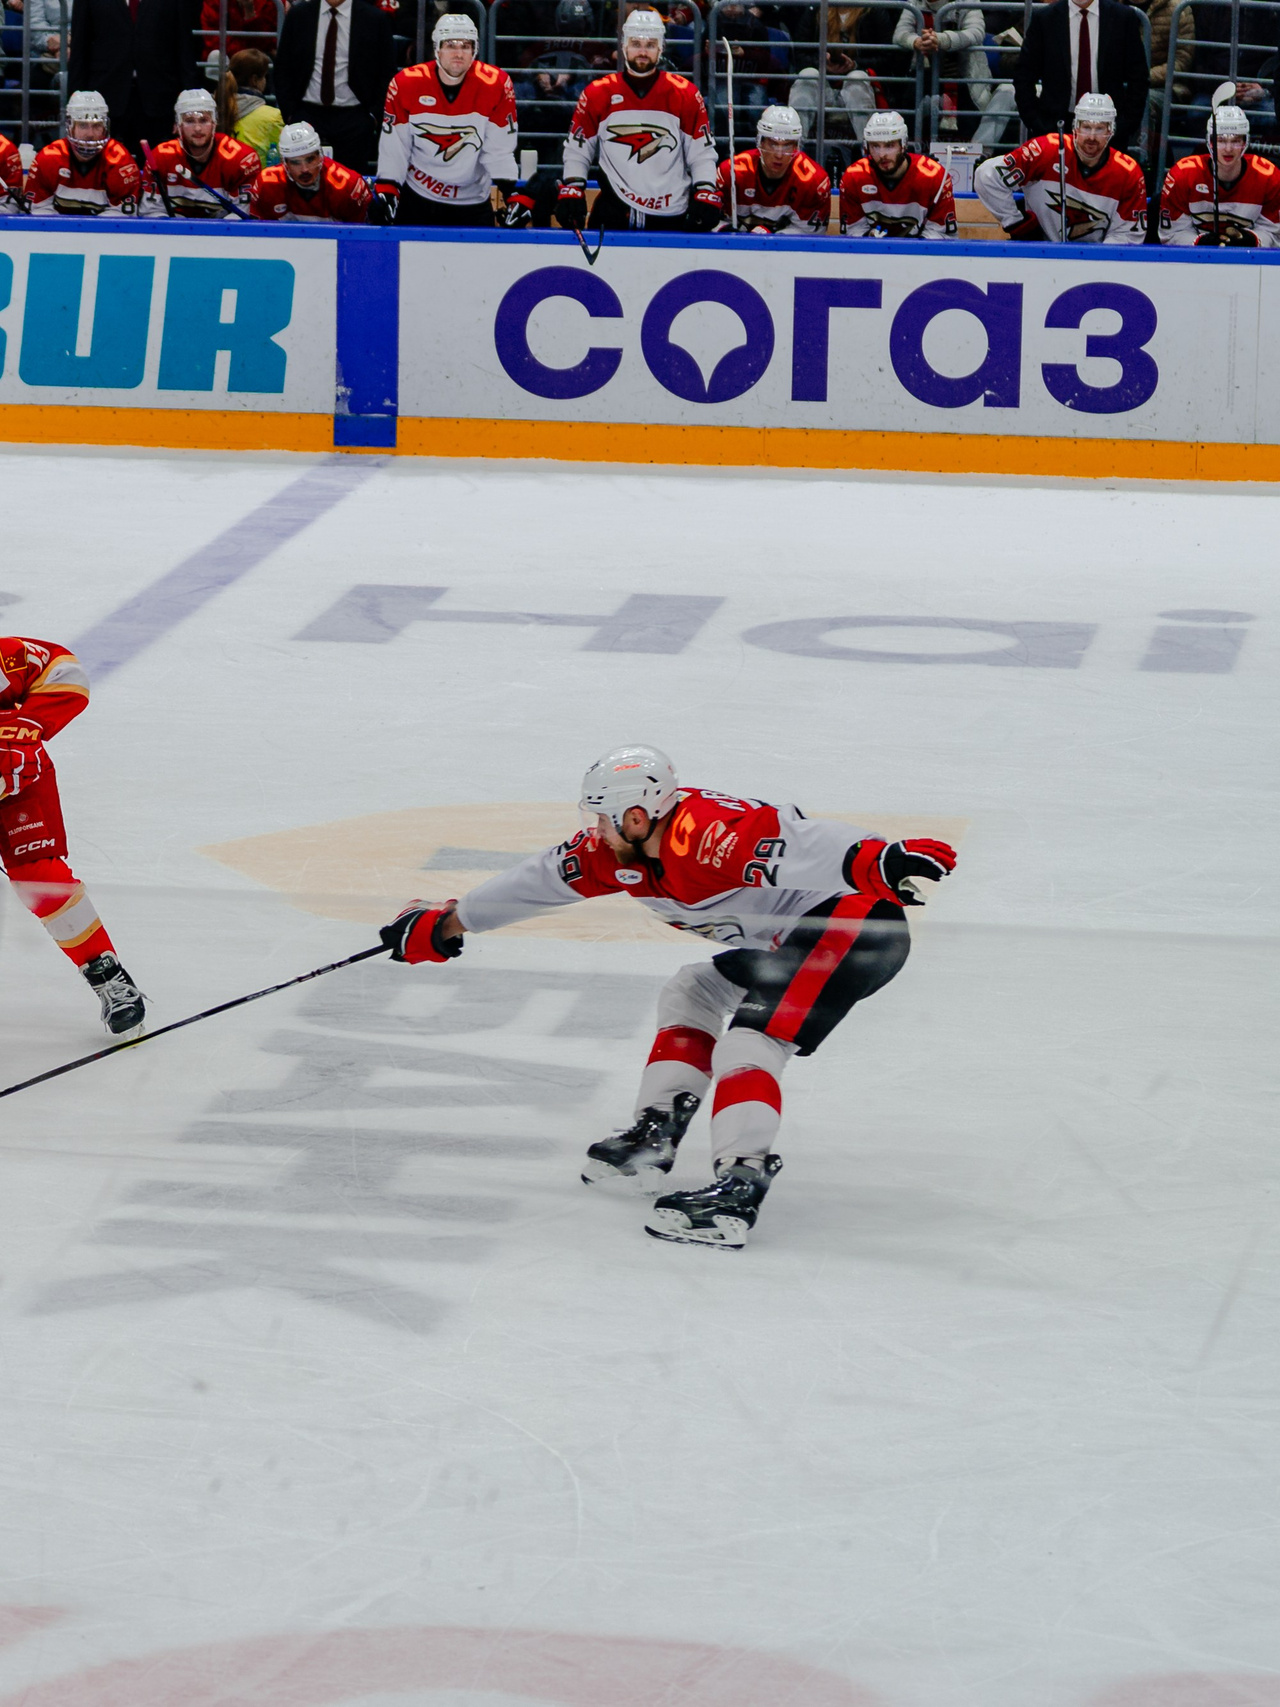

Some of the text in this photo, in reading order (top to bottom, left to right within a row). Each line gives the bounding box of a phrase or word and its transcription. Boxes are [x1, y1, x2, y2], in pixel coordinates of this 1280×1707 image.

[996, 154, 1025, 188] 20
[494, 265, 1160, 415] согаз
[14, 838, 56, 856] CCM
[742, 836, 788, 888] 29
